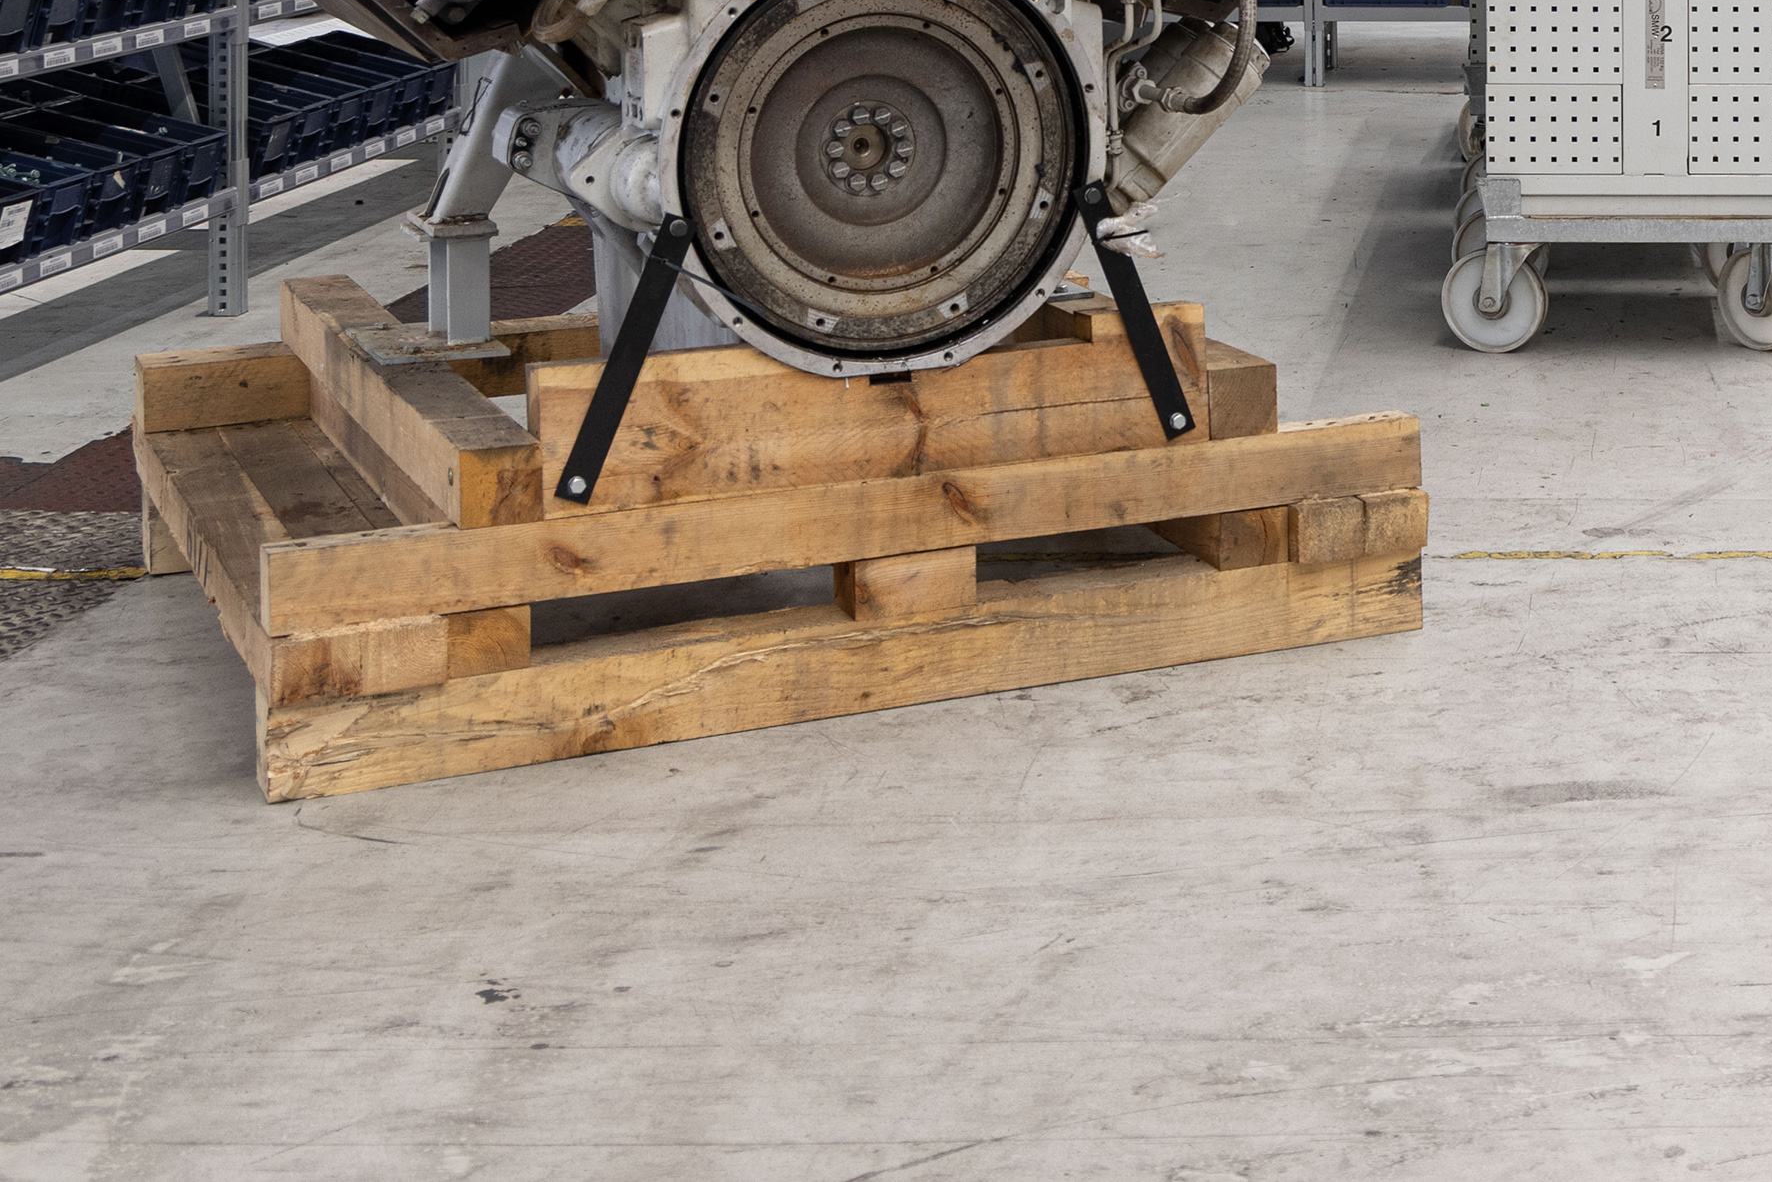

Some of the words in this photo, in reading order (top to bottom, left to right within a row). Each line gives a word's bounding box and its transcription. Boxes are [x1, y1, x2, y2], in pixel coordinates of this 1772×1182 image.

[1652, 14, 1660, 36] SMW
[1660, 25, 1672, 42] 2
[1652, 120, 1661, 136] 1
